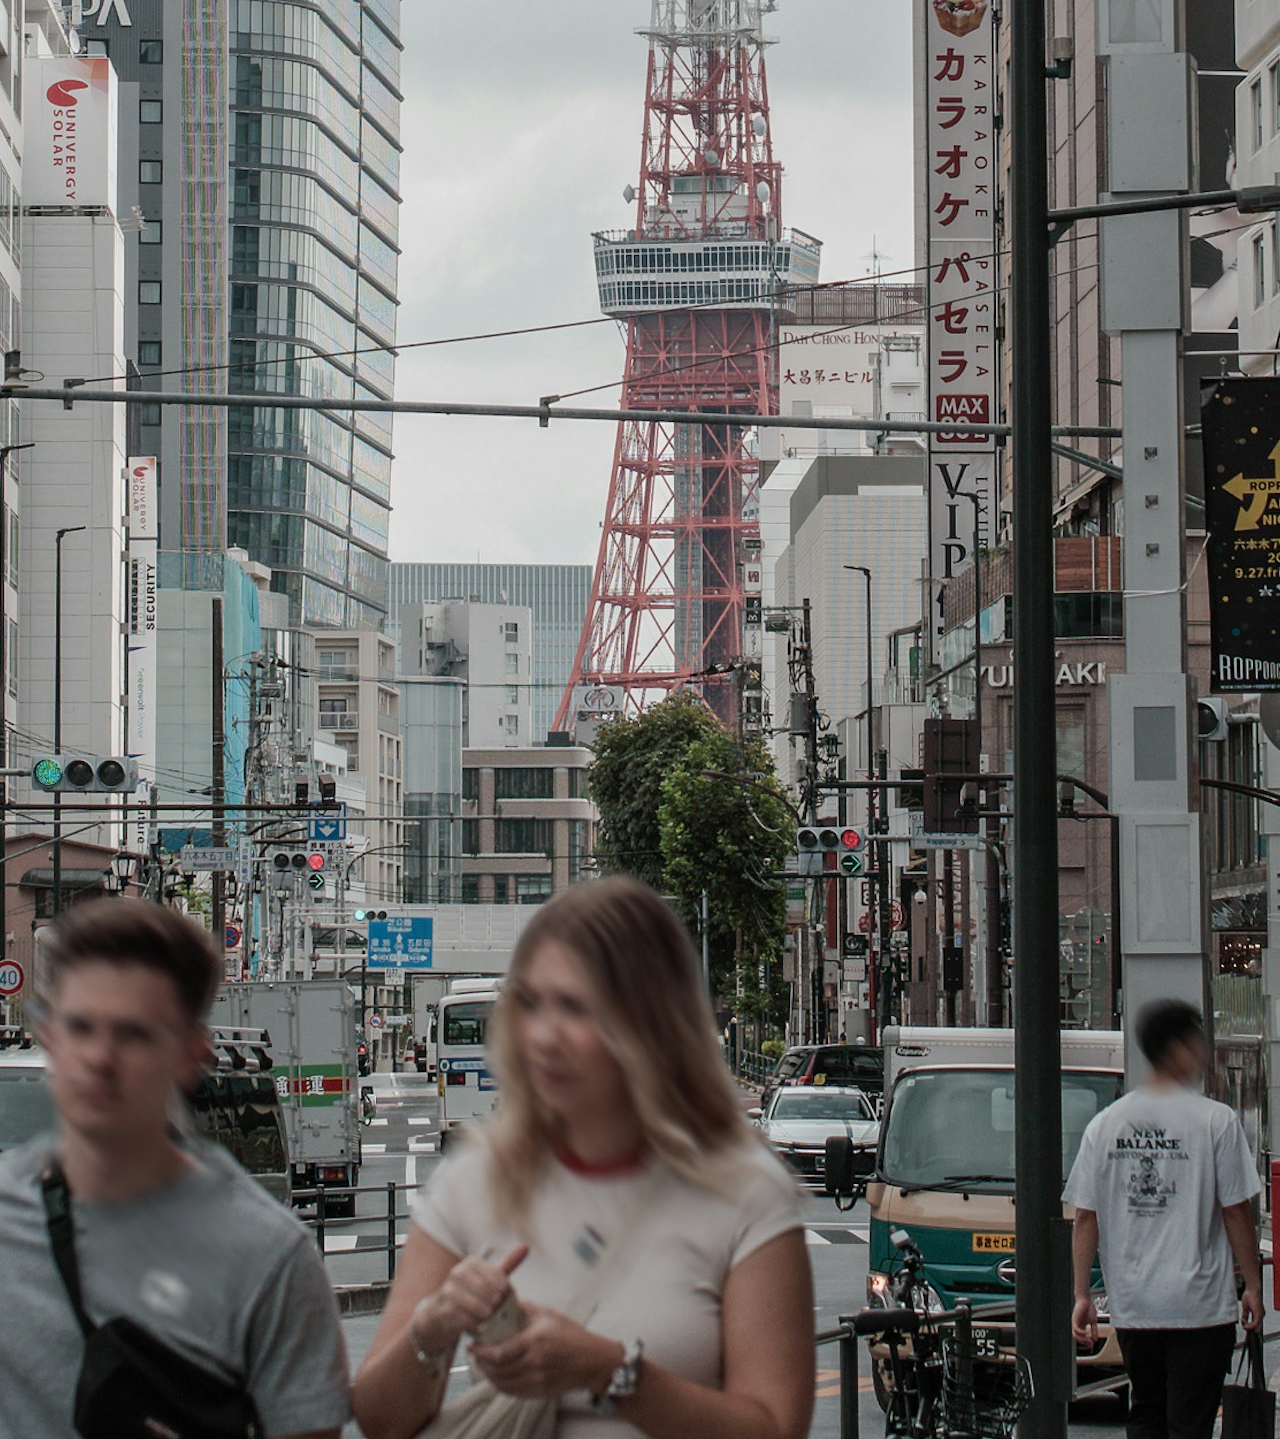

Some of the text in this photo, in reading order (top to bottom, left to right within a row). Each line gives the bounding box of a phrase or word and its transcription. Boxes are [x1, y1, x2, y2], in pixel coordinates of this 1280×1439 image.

[53, 109, 64, 167] SOLAR
[65, 109, 77, 200] UNIVERGY
[934, 47, 970, 227] カラオケ
[973, 54, 988, 218] KARAOKE
[811, 331, 851, 345] CHONG
[934, 251, 971, 383] パセラ
[975, 260, 989, 377] PASELA
[783, 368, 874, 385] 大昌第二ビル
[940, 397, 984, 415] MAX
[132, 477, 140, 512] SOLAR
[139, 477, 147, 531] UNIVERGY
[934, 463, 970, 580] VIP
[146, 563, 156, 631] SECURITY
[183, 851, 233, 861] 六本木五丁目
[1116, 1137, 1181, 1150] BALANCE
[1133, 1128, 1166, 1139] NEW
[1170, 1151, 1189, 1161] USA
[976, 1339, 997, 1356] 55
